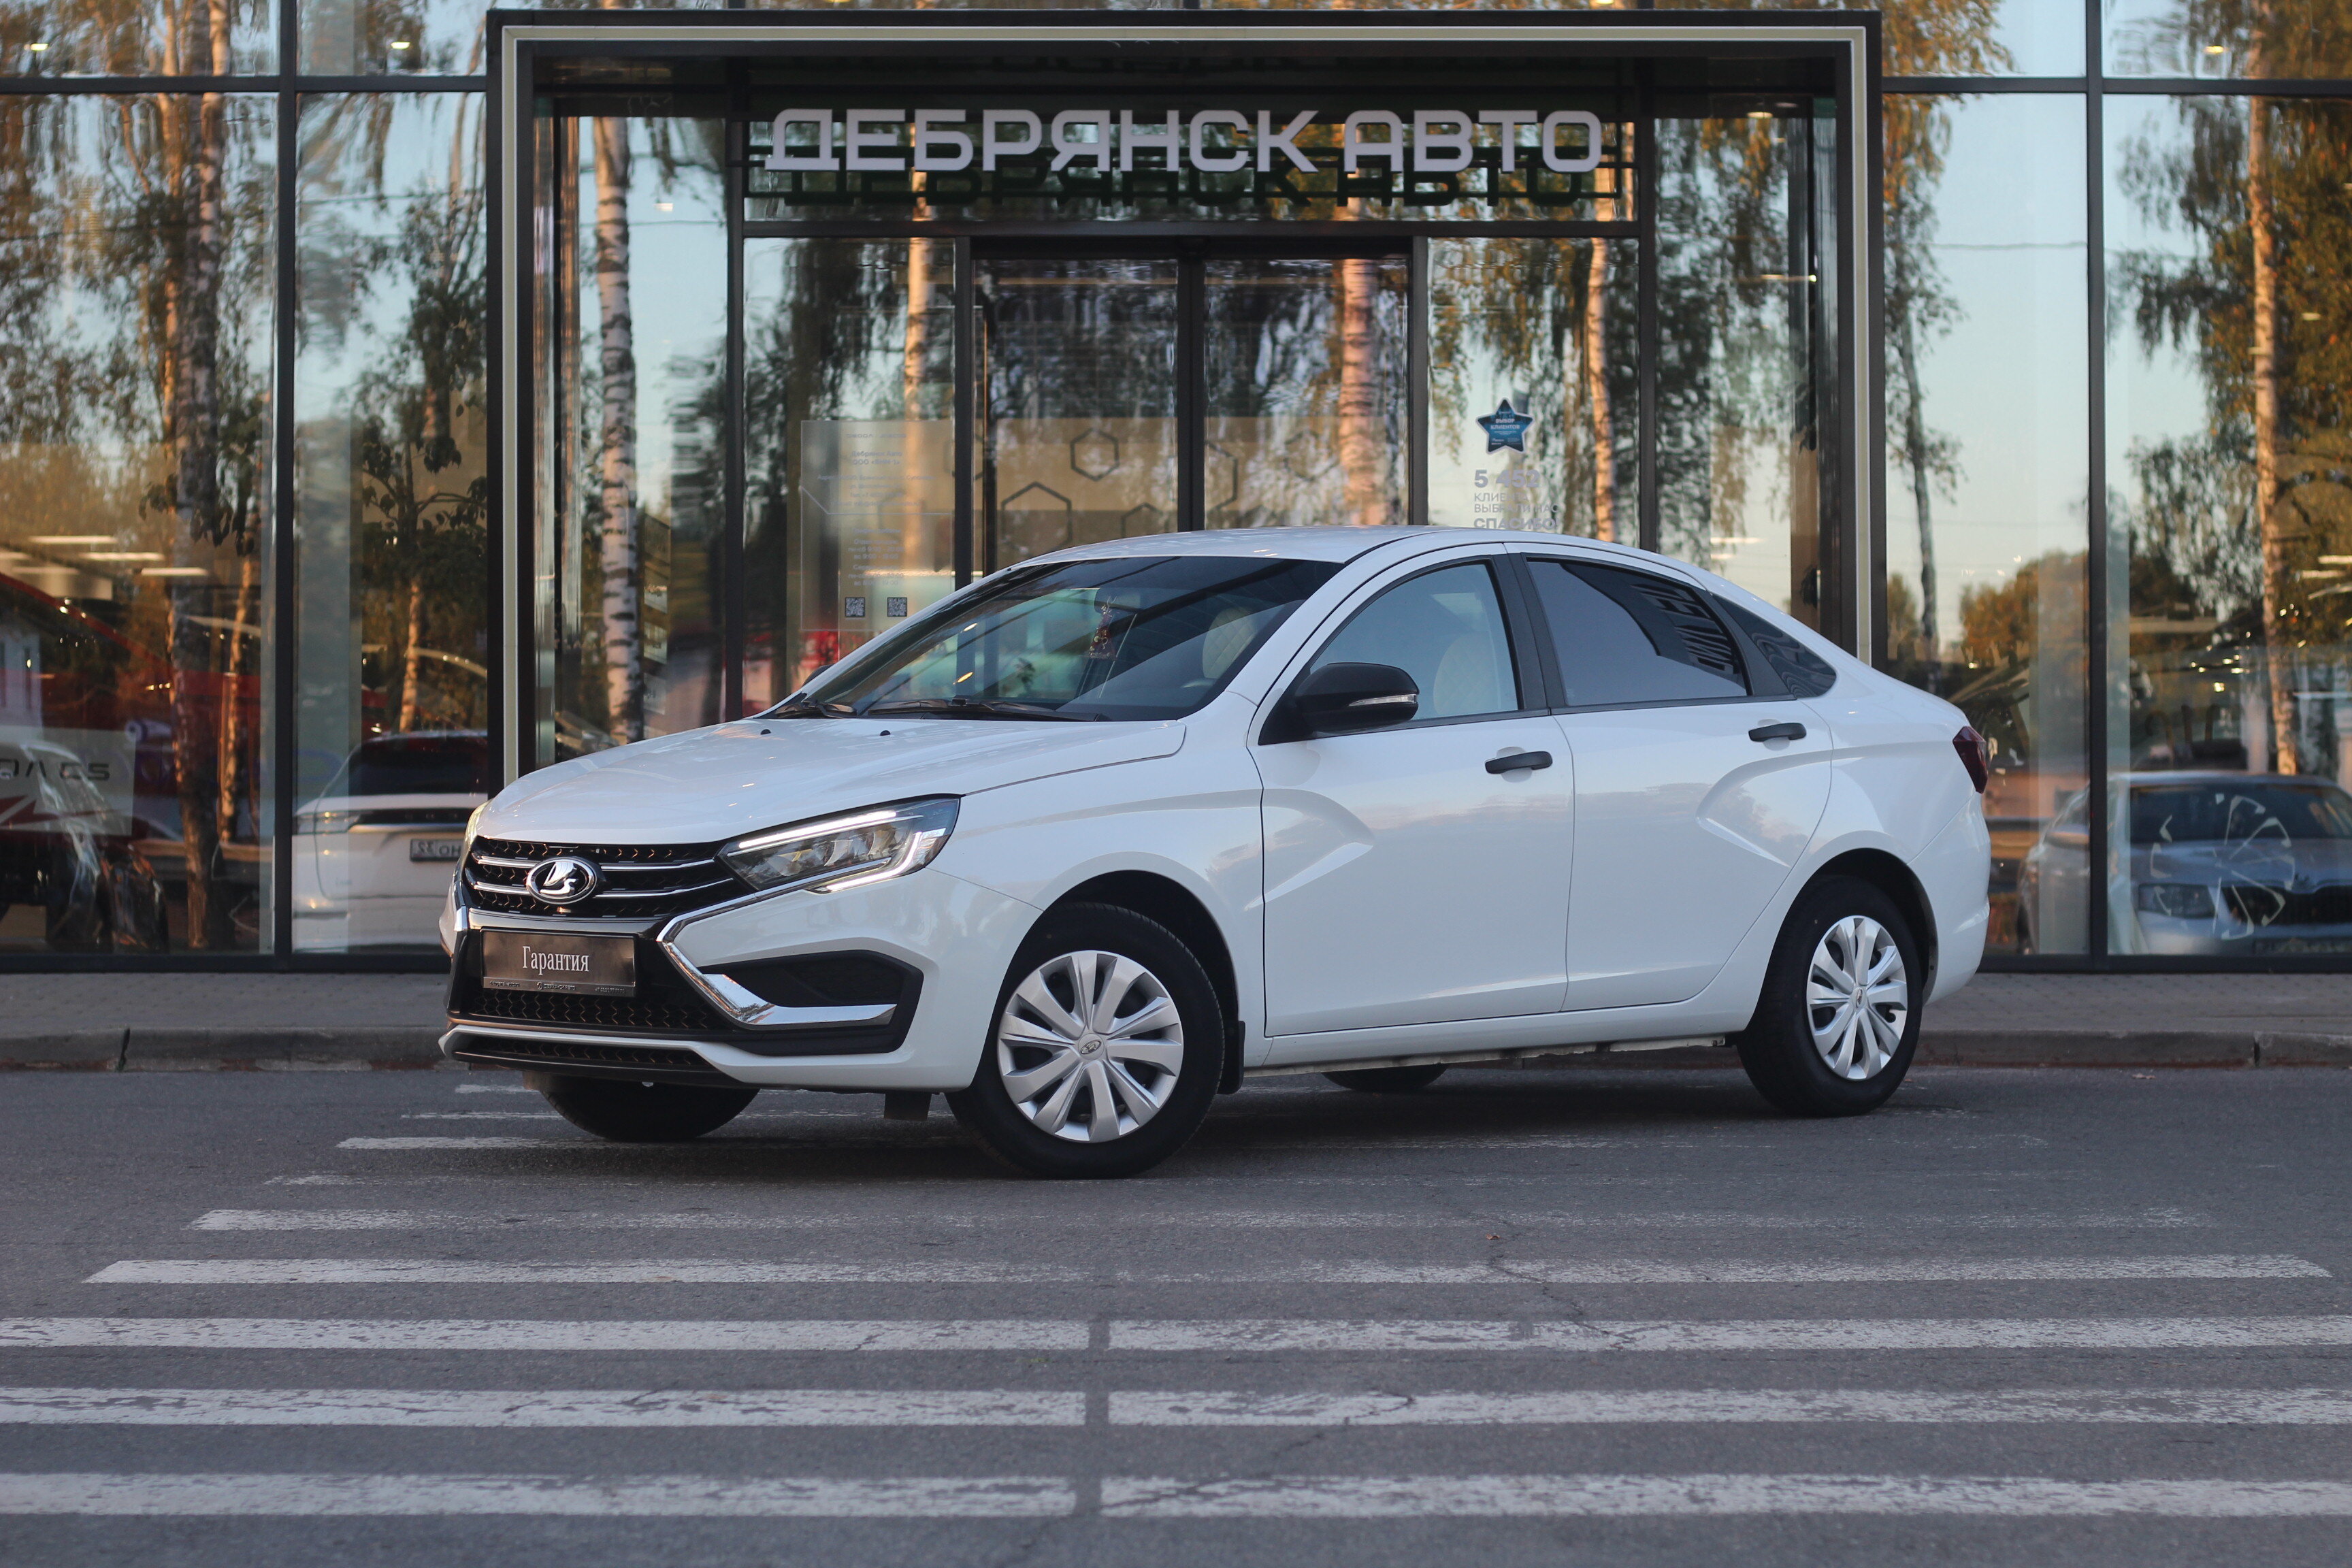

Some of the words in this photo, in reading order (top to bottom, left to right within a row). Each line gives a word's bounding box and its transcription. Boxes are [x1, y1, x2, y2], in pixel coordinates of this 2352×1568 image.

[765, 109, 1318, 173] ДЕБРЯНСК
[1343, 110, 1602, 174] АВТО
[1474, 469, 1489, 488] 5
[1495, 469, 1541, 488] 452
[522, 946, 589, 976] Гарантия
